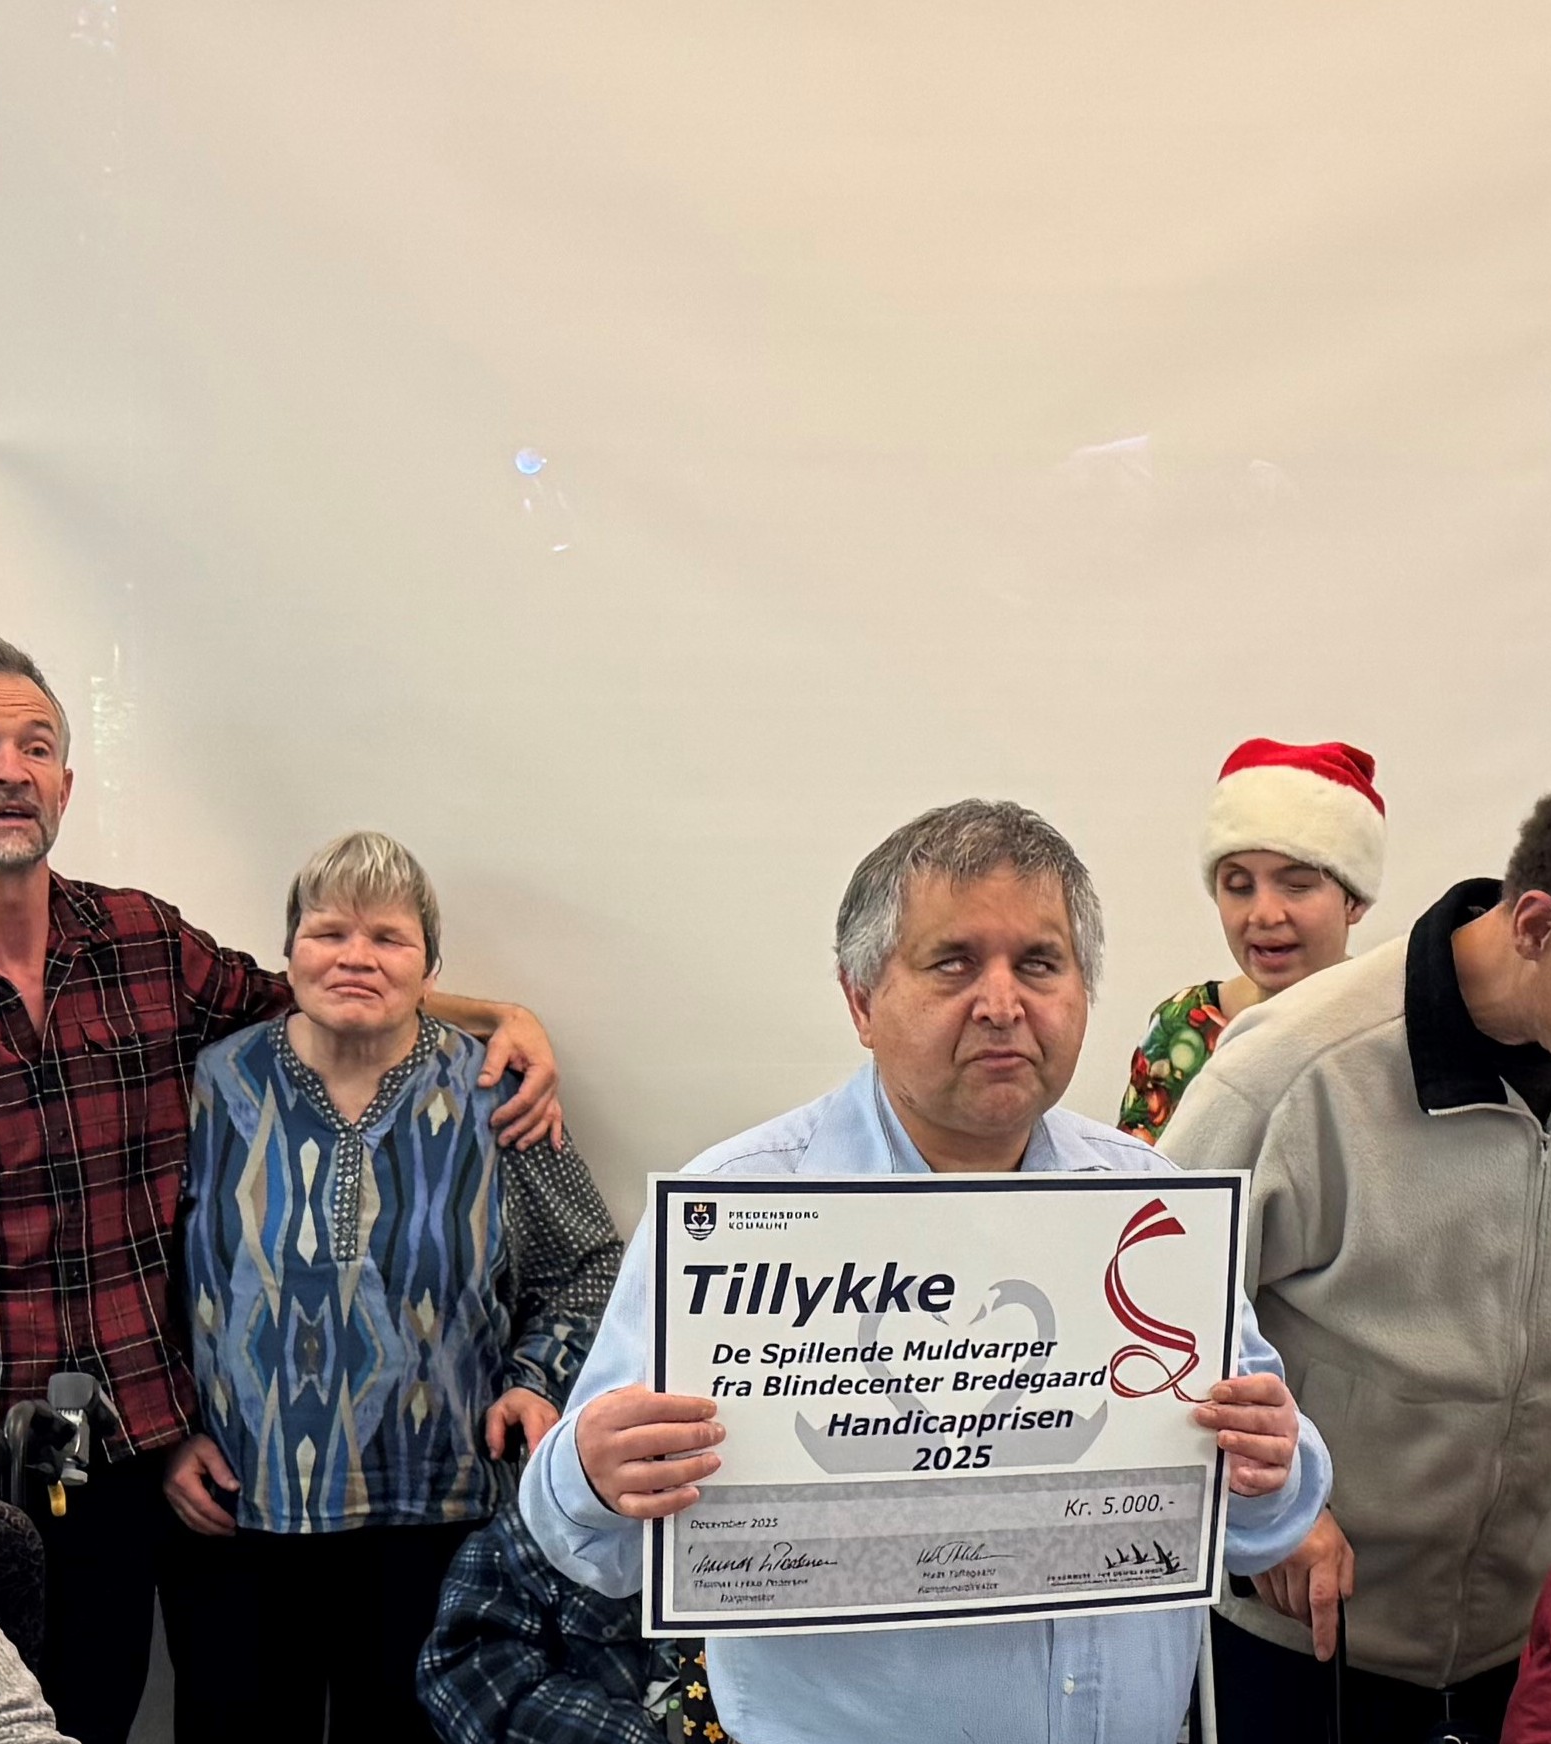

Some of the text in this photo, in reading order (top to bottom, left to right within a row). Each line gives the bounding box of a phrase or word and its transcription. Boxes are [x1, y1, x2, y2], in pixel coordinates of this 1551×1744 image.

[683, 1262, 955, 1328] Tillykke
[712, 1338, 1058, 1369] De Spillende Muldvarper
[711, 1365, 1108, 1397] fra Blindecenter Bredegaard
[827, 1406, 1074, 1438] Handicapprisen
[912, 1445, 993, 1471] 2025
[1064, 1494, 1175, 1518] Kr. 5.000.-
